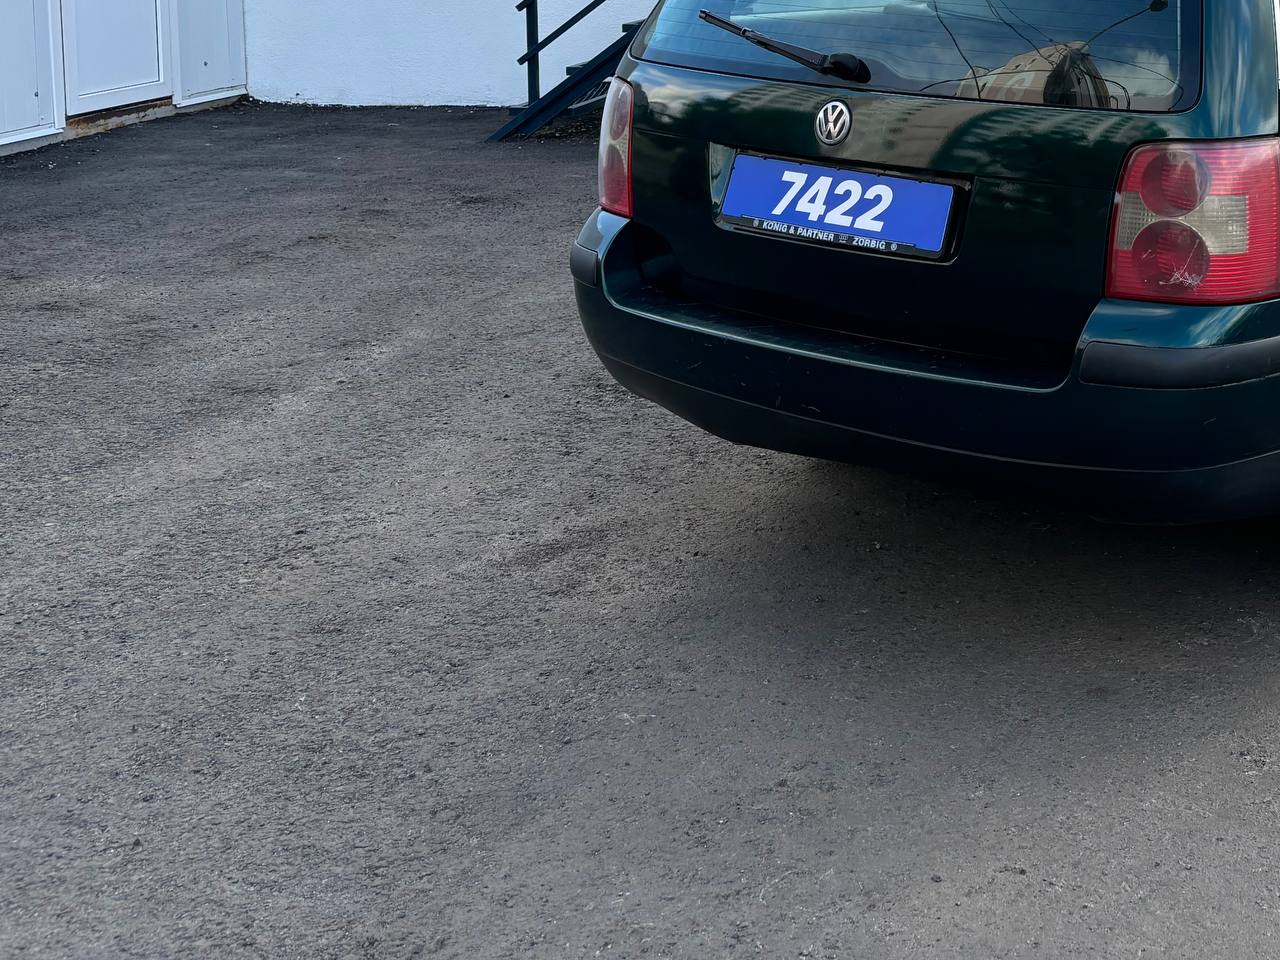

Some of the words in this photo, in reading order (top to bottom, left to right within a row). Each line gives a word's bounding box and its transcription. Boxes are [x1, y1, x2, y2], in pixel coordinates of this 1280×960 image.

[771, 169, 894, 233] 7422
[788, 224, 796, 235] &
[796, 226, 835, 242] PARTNER
